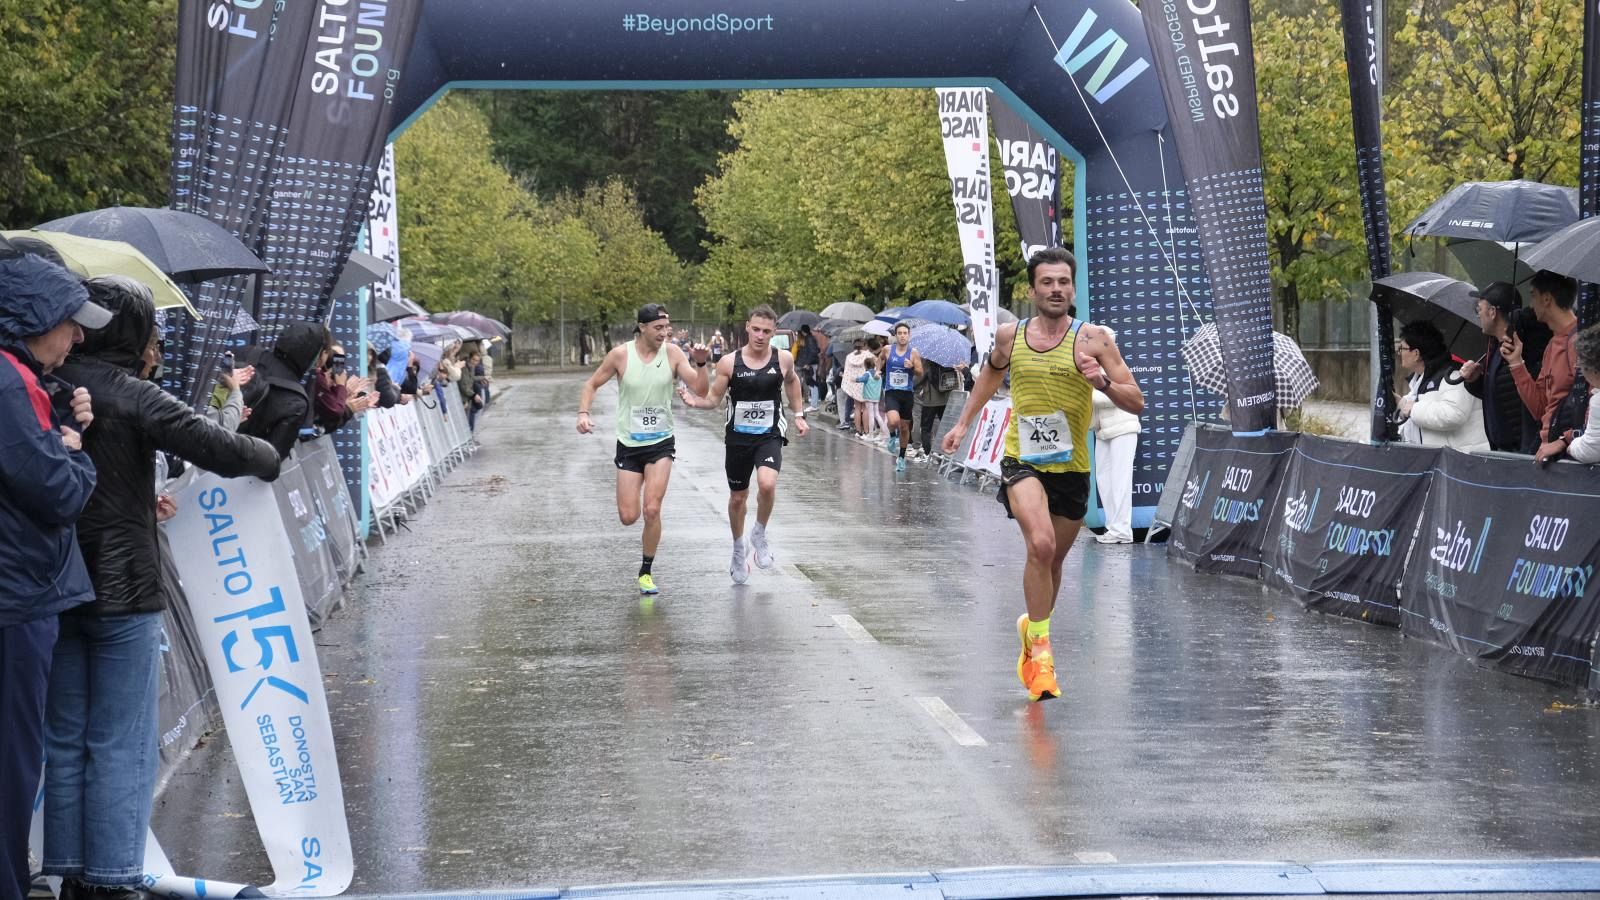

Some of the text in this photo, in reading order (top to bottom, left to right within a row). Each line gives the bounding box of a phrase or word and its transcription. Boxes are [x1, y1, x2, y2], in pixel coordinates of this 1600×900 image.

[623, 13, 774, 35] #BeyondSport
[383, 68, 401, 105] .org
[1448, 219, 1494, 229] INESIS
[642, 416, 657, 425] 88
[743, 410, 766, 419] 202
[198, 486, 253, 596] SALTO
[1525, 514, 1569, 551] SALTO
[256, 714, 295, 805] SEBASTIAN
[288, 715, 318, 801] DONOSTIA
[289, 768, 306, 802] SAN
[300, 836, 324, 890] SA
